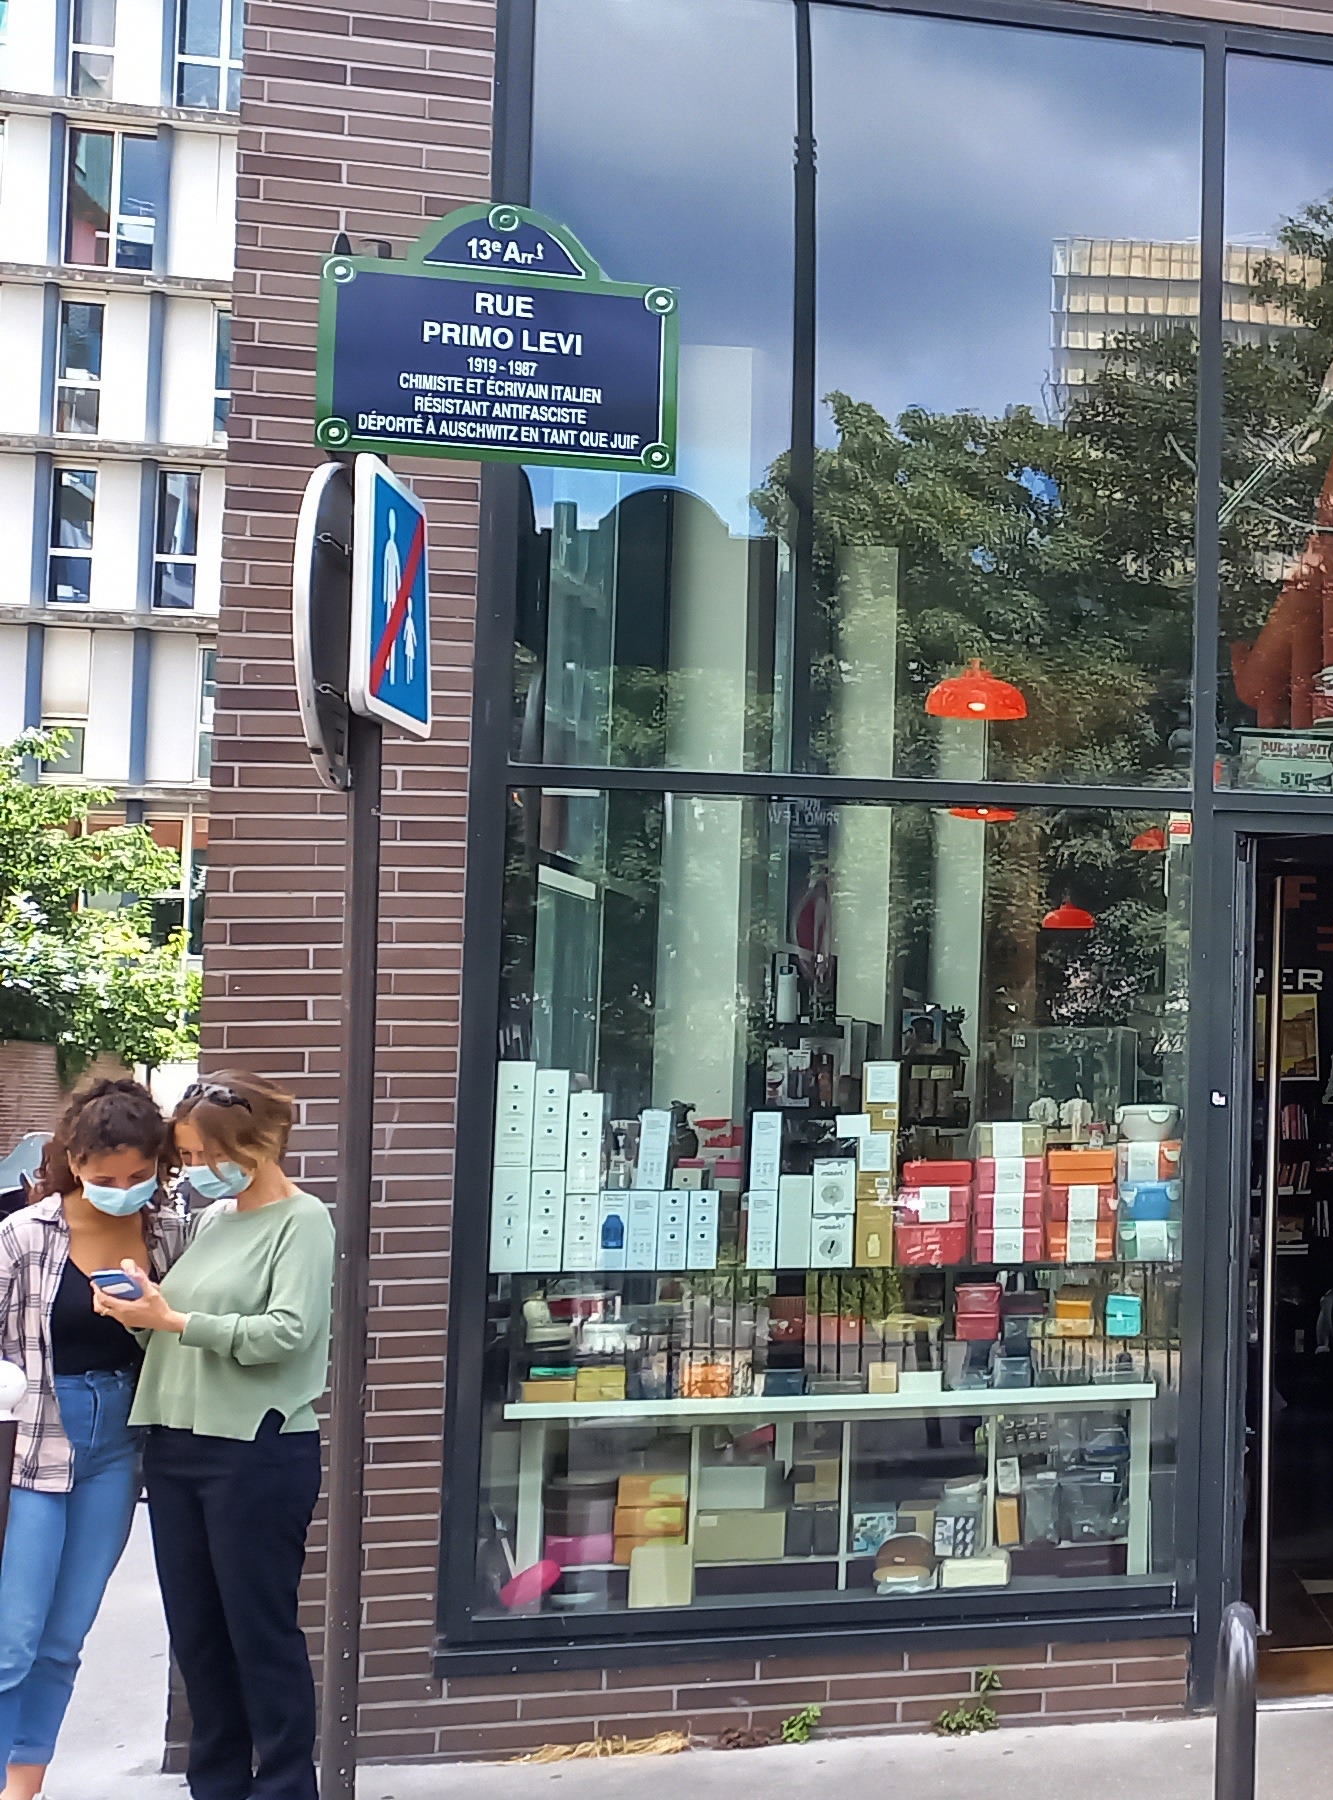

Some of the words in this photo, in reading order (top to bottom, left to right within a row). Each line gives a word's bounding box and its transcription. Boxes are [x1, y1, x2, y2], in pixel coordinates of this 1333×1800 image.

[467, 237, 501, 261] 13e
[475, 291, 534, 319] RUE
[422, 320, 514, 351] PRIMO
[522, 327, 583, 356] LEVI
[467, 356, 498, 374] 1919
[507, 359, 537, 377] 1987
[399, 372, 463, 394] CHIMISTE
[466, 376, 483, 394] ET
[485, 376, 549, 400] ÉCRIVAIN
[551, 384, 602, 404] ITALIEN
[414, 394, 490, 417] RÉSISTANT
[491, 402, 588, 425] ANTIFASCISTE
[357, 410, 423, 435] DÉPORTÉ
[426, 416, 436, 435] À
[438, 422, 518, 443] AUSCHWITZ
[520, 427, 538, 444] EN
[541, 428, 579, 447] TANT
[579, 430, 609, 448] QUE
[610, 432, 640, 451] JUIF
